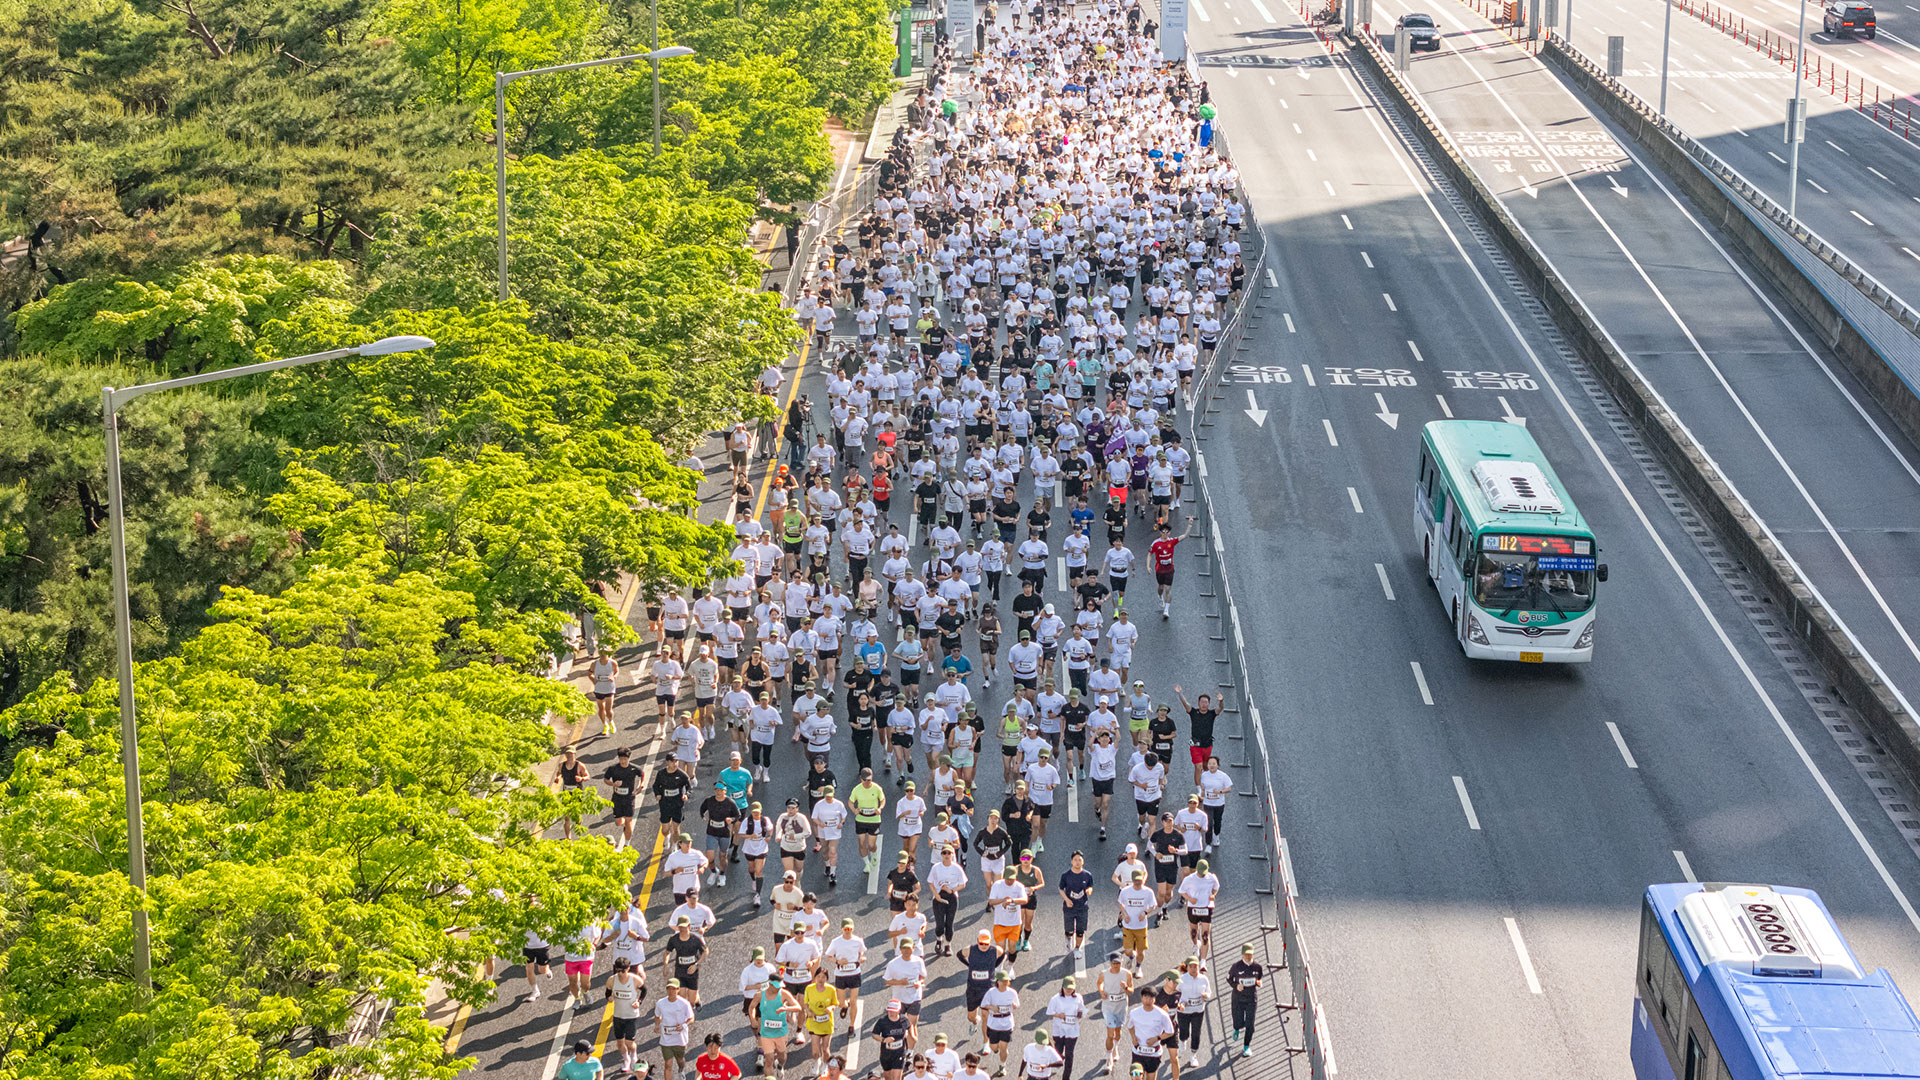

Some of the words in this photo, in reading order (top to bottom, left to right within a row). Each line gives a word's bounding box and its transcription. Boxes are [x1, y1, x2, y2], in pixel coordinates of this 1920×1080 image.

[1222, 365, 1292, 384] 영등
[1324, 367, 1417, 387] 영등포
[1442, 370, 1540, 391] 영등포
[1530, 614, 1548, 622] BUS
